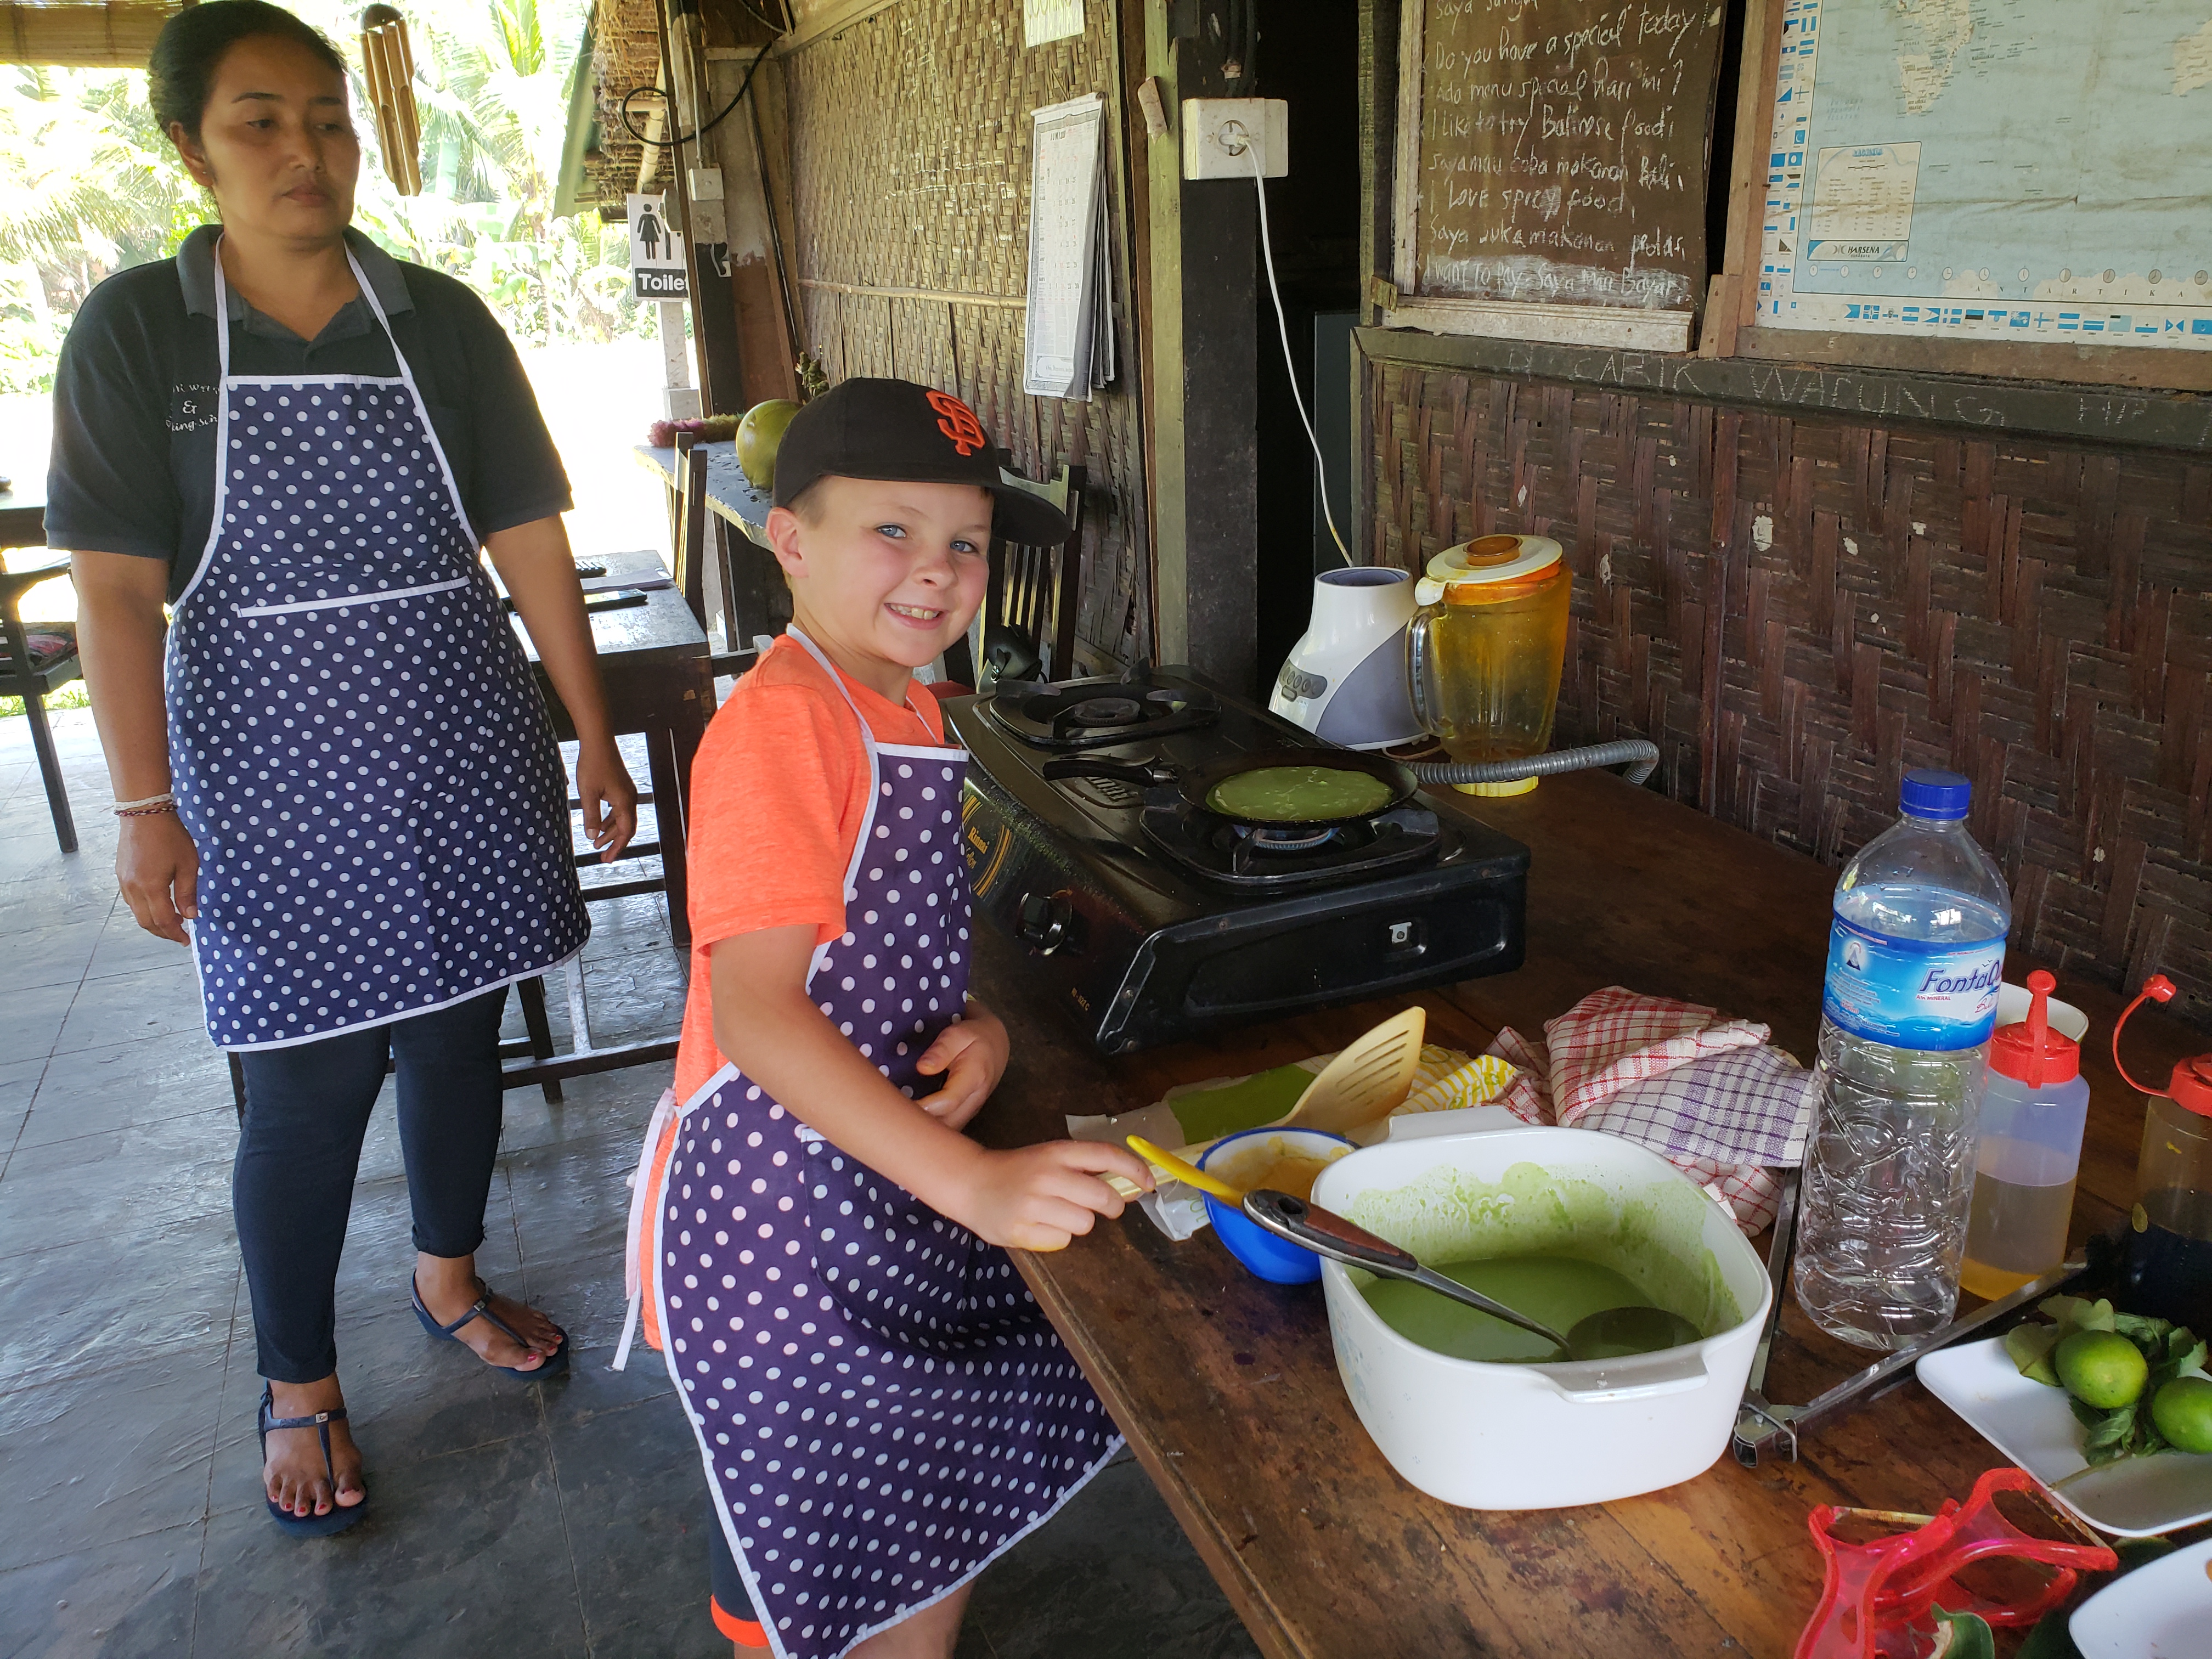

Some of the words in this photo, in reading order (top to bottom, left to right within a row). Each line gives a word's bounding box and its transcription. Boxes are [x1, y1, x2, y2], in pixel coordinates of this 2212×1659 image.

[1436, 41, 1455, 70] Do
[1462, 48, 1492, 79] you
[1499, 26, 1538, 60] have
[1847, 246, 1880, 257] HARSENA
[968, 826, 990, 854] Rinnai
